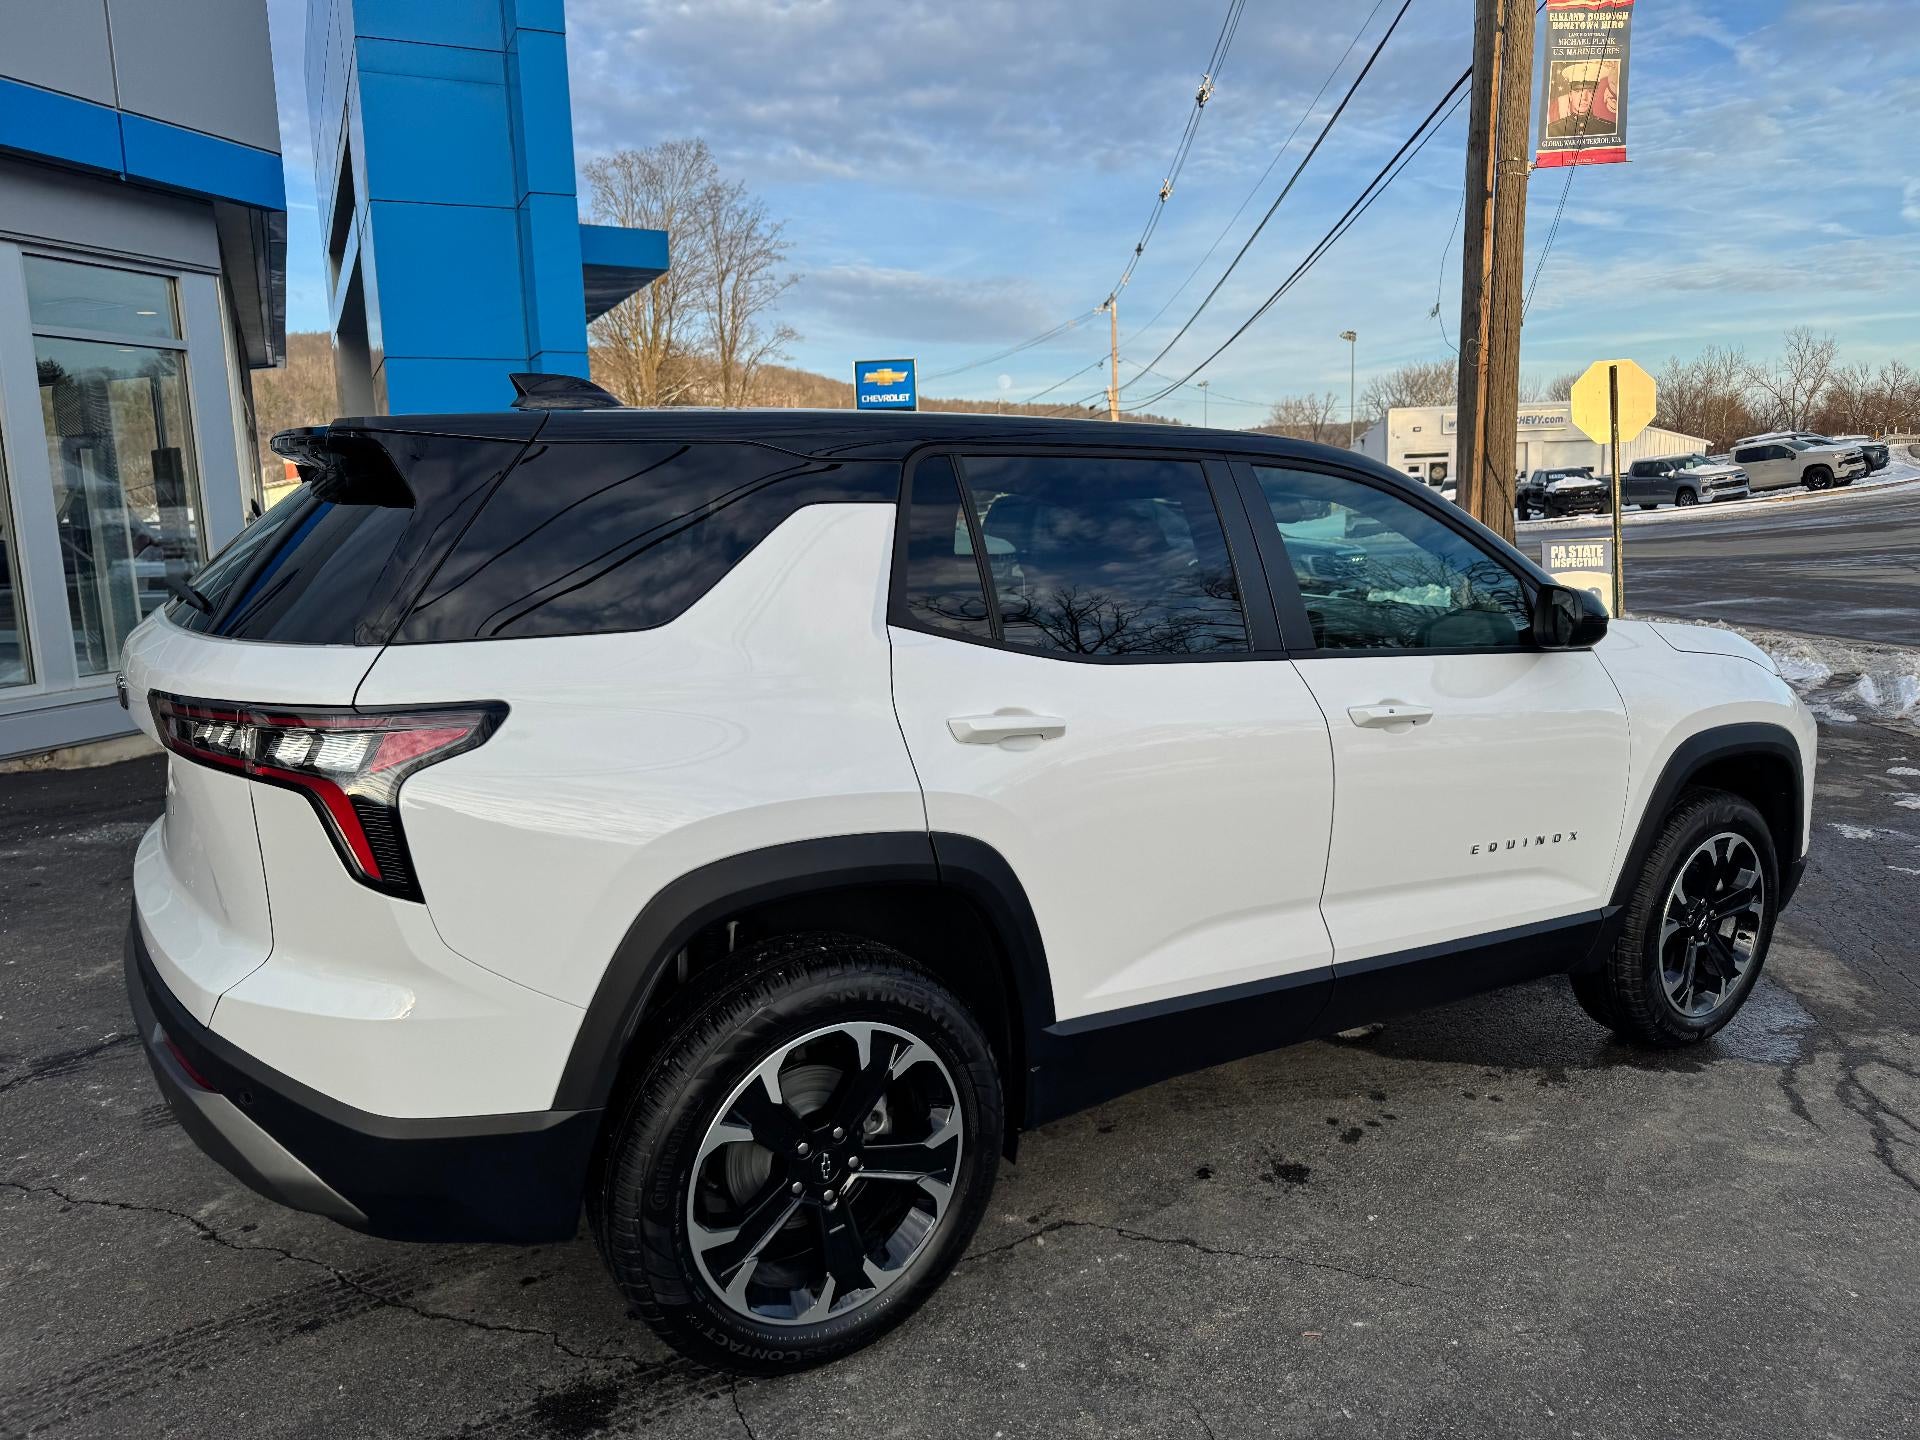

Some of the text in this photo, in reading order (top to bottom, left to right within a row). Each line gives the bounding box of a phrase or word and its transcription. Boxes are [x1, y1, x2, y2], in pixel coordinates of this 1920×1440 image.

[1587, 11, 1629, 21] BOROUGH
[1552, 20, 1624, 30] HOMETOWN HERO
[1558, 37, 1616, 46] MICHAEL PLANK
[1566, 48, 1595, 56] MARINE
[1596, 47, 1620, 55] CORPS
[861, 393, 910, 403] CHEVROLET
[1550, 544, 1604, 558] PA STATE
[1551, 557, 1604, 568] INSPECTION
[1470, 831, 1578, 855] EQUINOX
